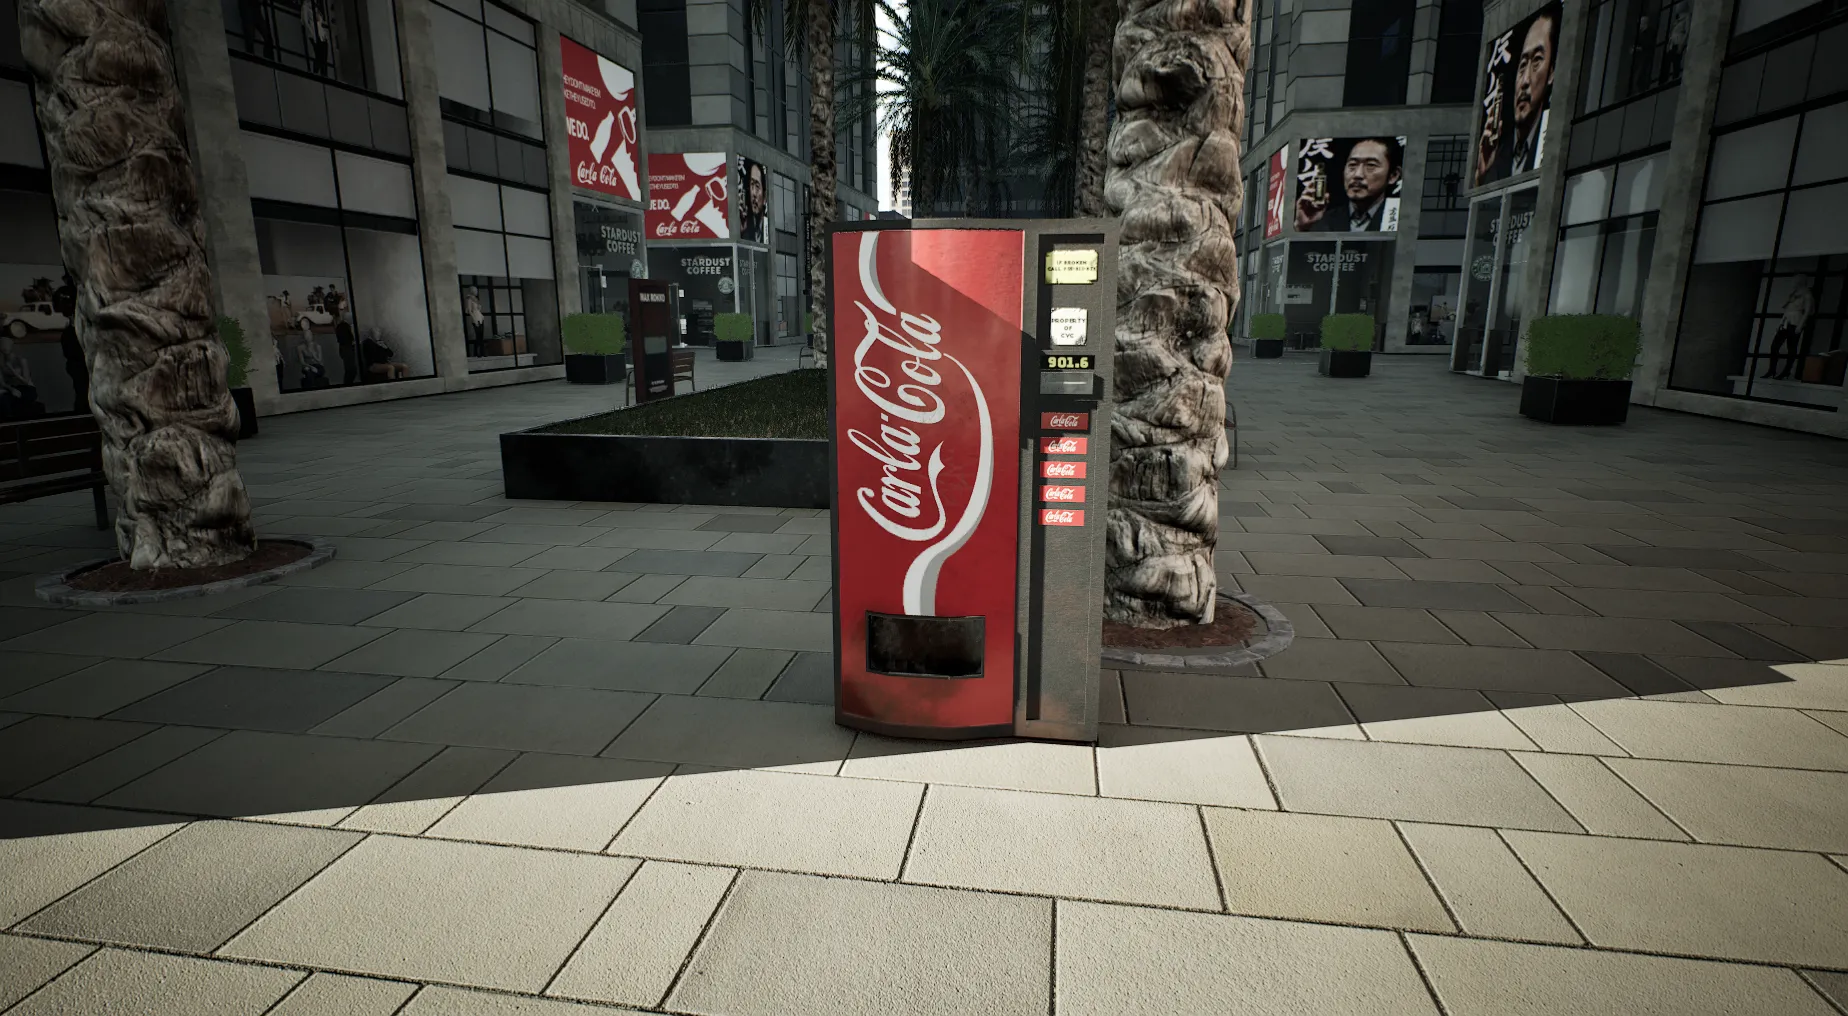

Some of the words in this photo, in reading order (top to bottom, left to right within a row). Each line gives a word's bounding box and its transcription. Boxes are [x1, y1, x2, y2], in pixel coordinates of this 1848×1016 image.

[577, 160, 598, 185] Carla
[600, 165, 617, 187] Cola
[680, 220, 700, 233] Cola
[601, 225, 641, 244] STARDUST
[606, 239, 635, 256] COFFEE
[681, 258, 730, 267] STARDUST
[686, 266, 721, 275] COFFEE
[1047, 356, 1089, 369] 901.6
